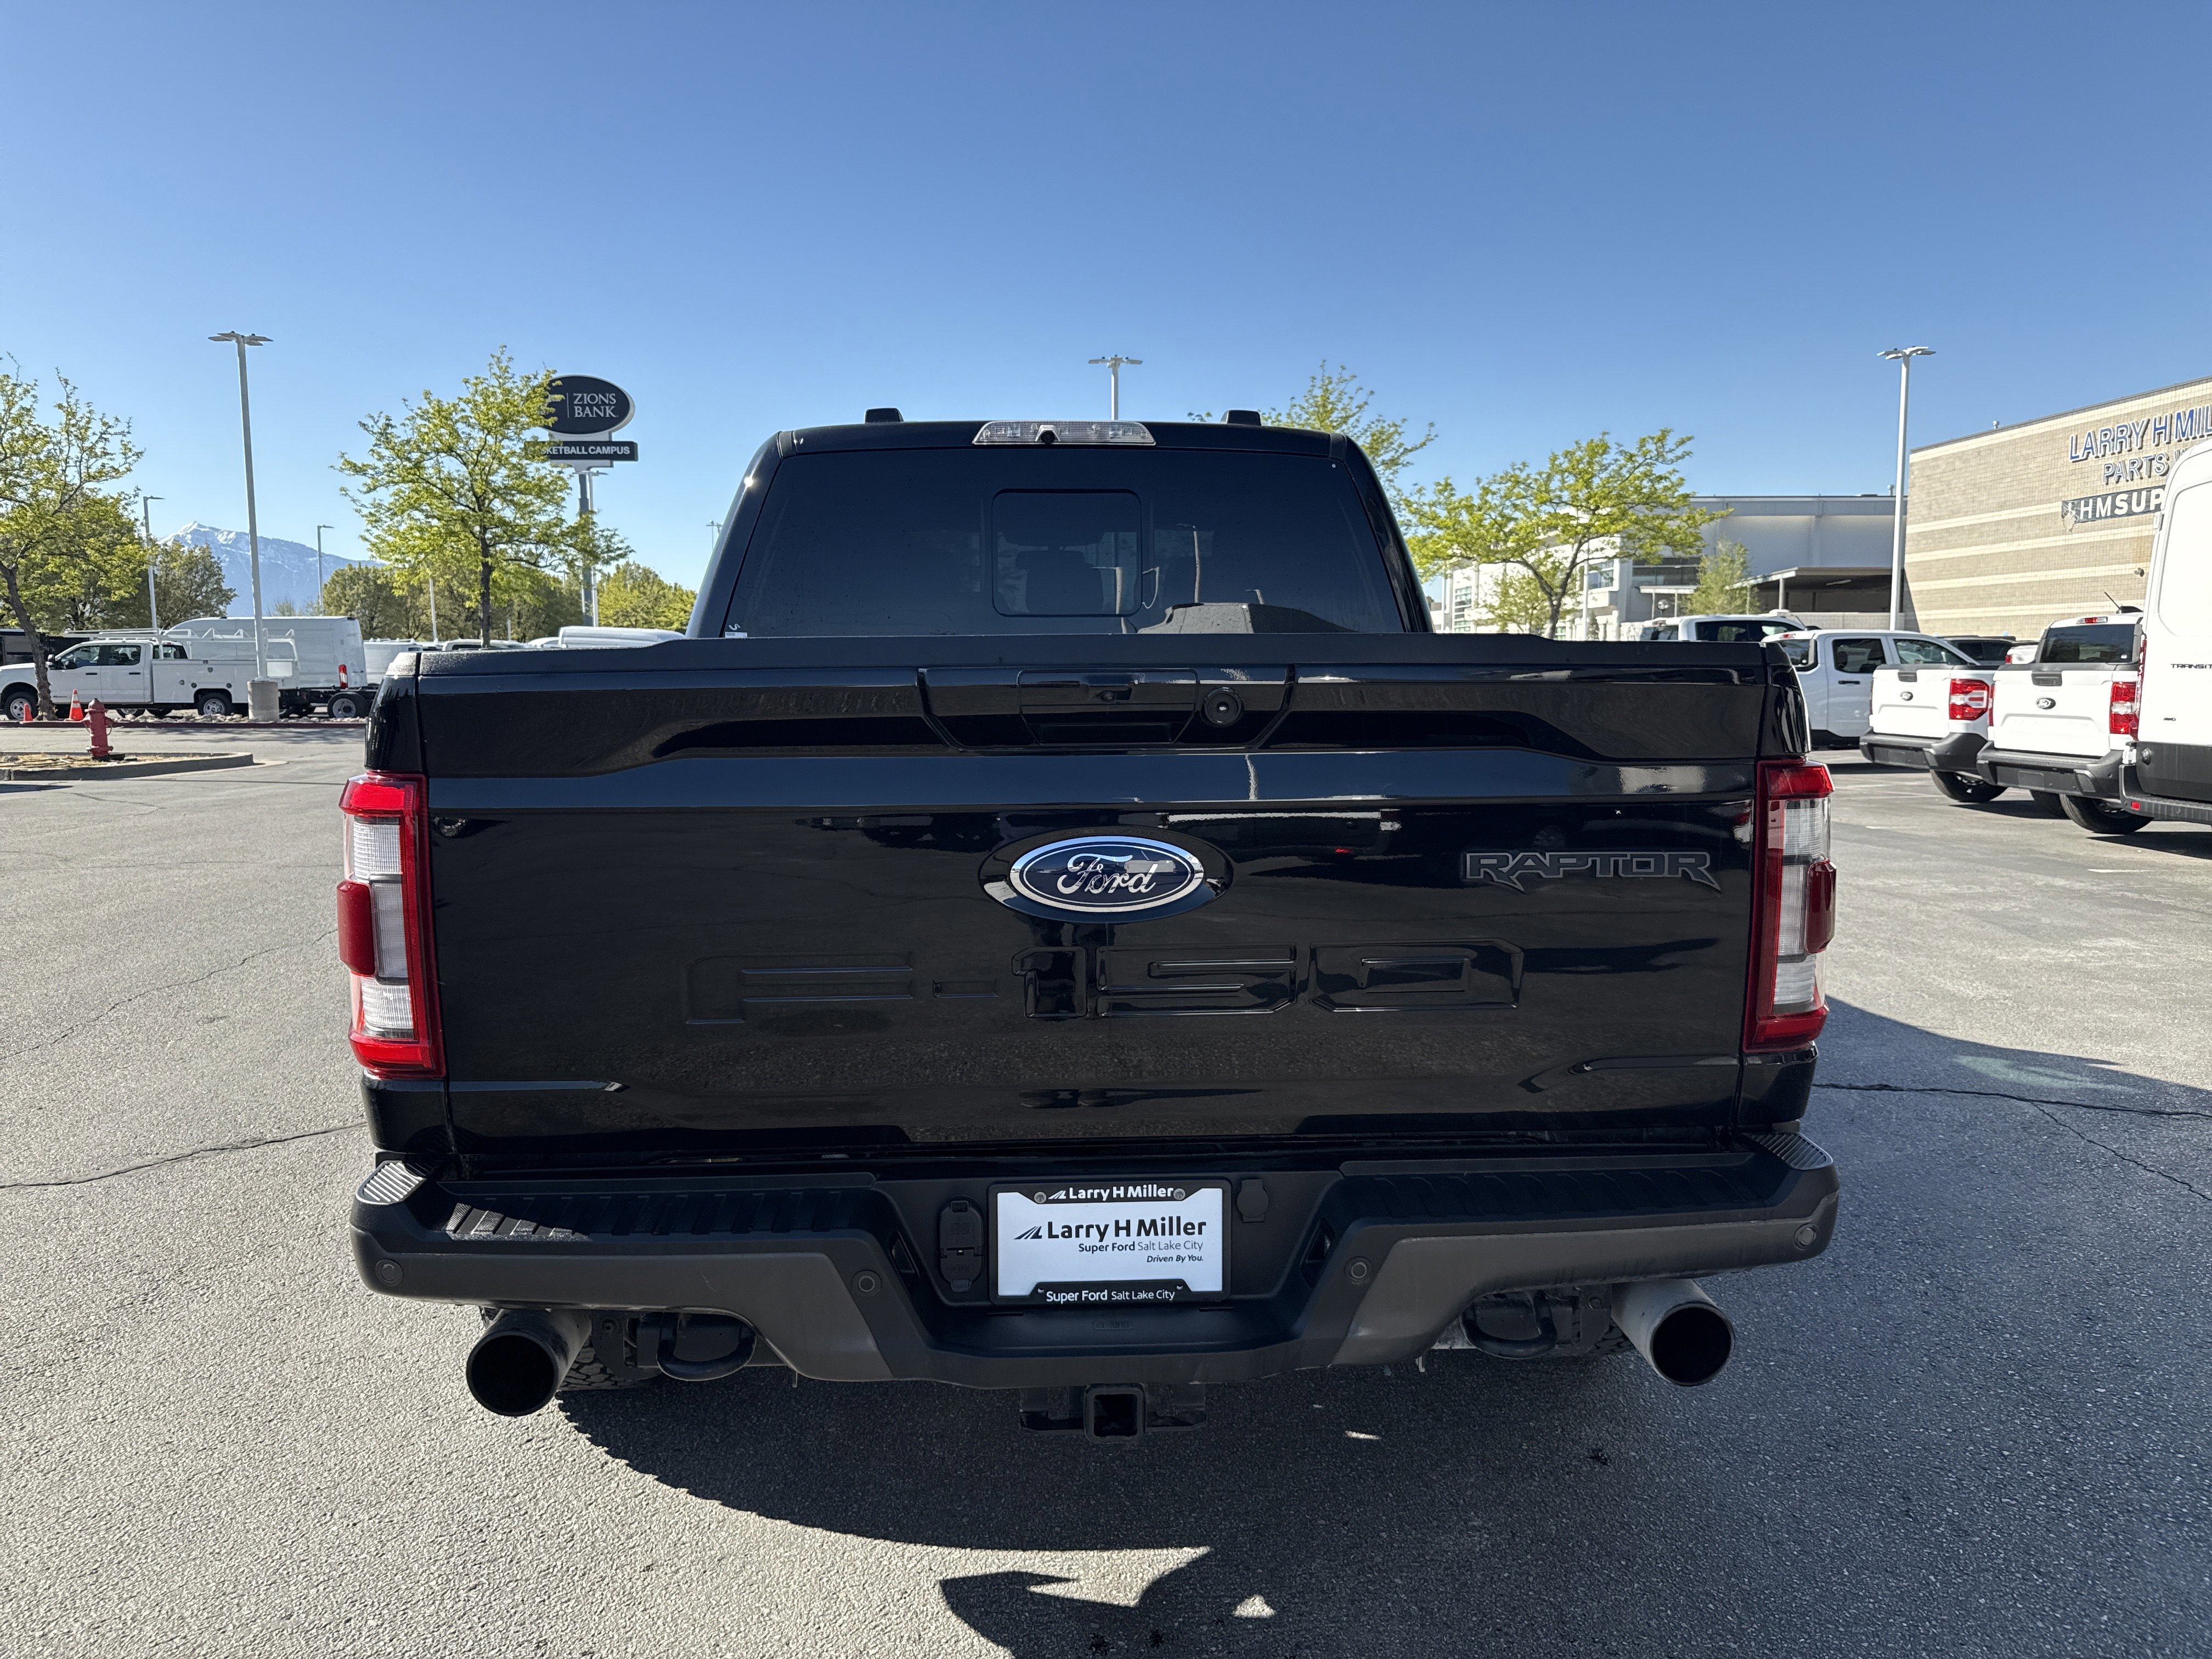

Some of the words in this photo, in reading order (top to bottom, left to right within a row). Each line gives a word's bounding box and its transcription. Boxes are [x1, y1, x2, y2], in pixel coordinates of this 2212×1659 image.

[573, 393, 617, 404] ZIONS
[574, 405, 617, 417] BANK
[2068, 418, 2149, 462] LARRY
[2152, 414, 2171, 445] H
[589, 445, 630, 455] CAMPUS
[2103, 453, 2168, 484] PARTS
[1057, 853, 1157, 894] Ford
[1465, 851, 1722, 894] RAPTOR
[683, 938, 1524, 1026] F-150
[1069, 1187, 1109, 1201] Larry
[1113, 1186, 1124, 1198] H
[1127, 1183, 1174, 1198] Miller
[1047, 1221, 1109, 1243] Larry
[1114, 1219, 1131, 1237] H
[1136, 1216, 1206, 1237] Miller
[1078, 1243, 1109, 1254] Super
[1111, 1241, 1135, 1251] Ford
[1137, 1240, 1156, 1251] Salt
[1158, 1240, 1181, 1250] Lake
[1183, 1240, 1203, 1251] City
[1147, 1254, 1173, 1262] Driven
[1176, 1254, 1186, 1263] By
[1046, 1290, 1079, 1304] Super
[1081, 1289, 1108, 1301] Ford
[1111, 1289, 1130, 1300] Salt
[1132, 1289, 1154, 1300] Lake
[1155, 1289, 1175, 1301] City
